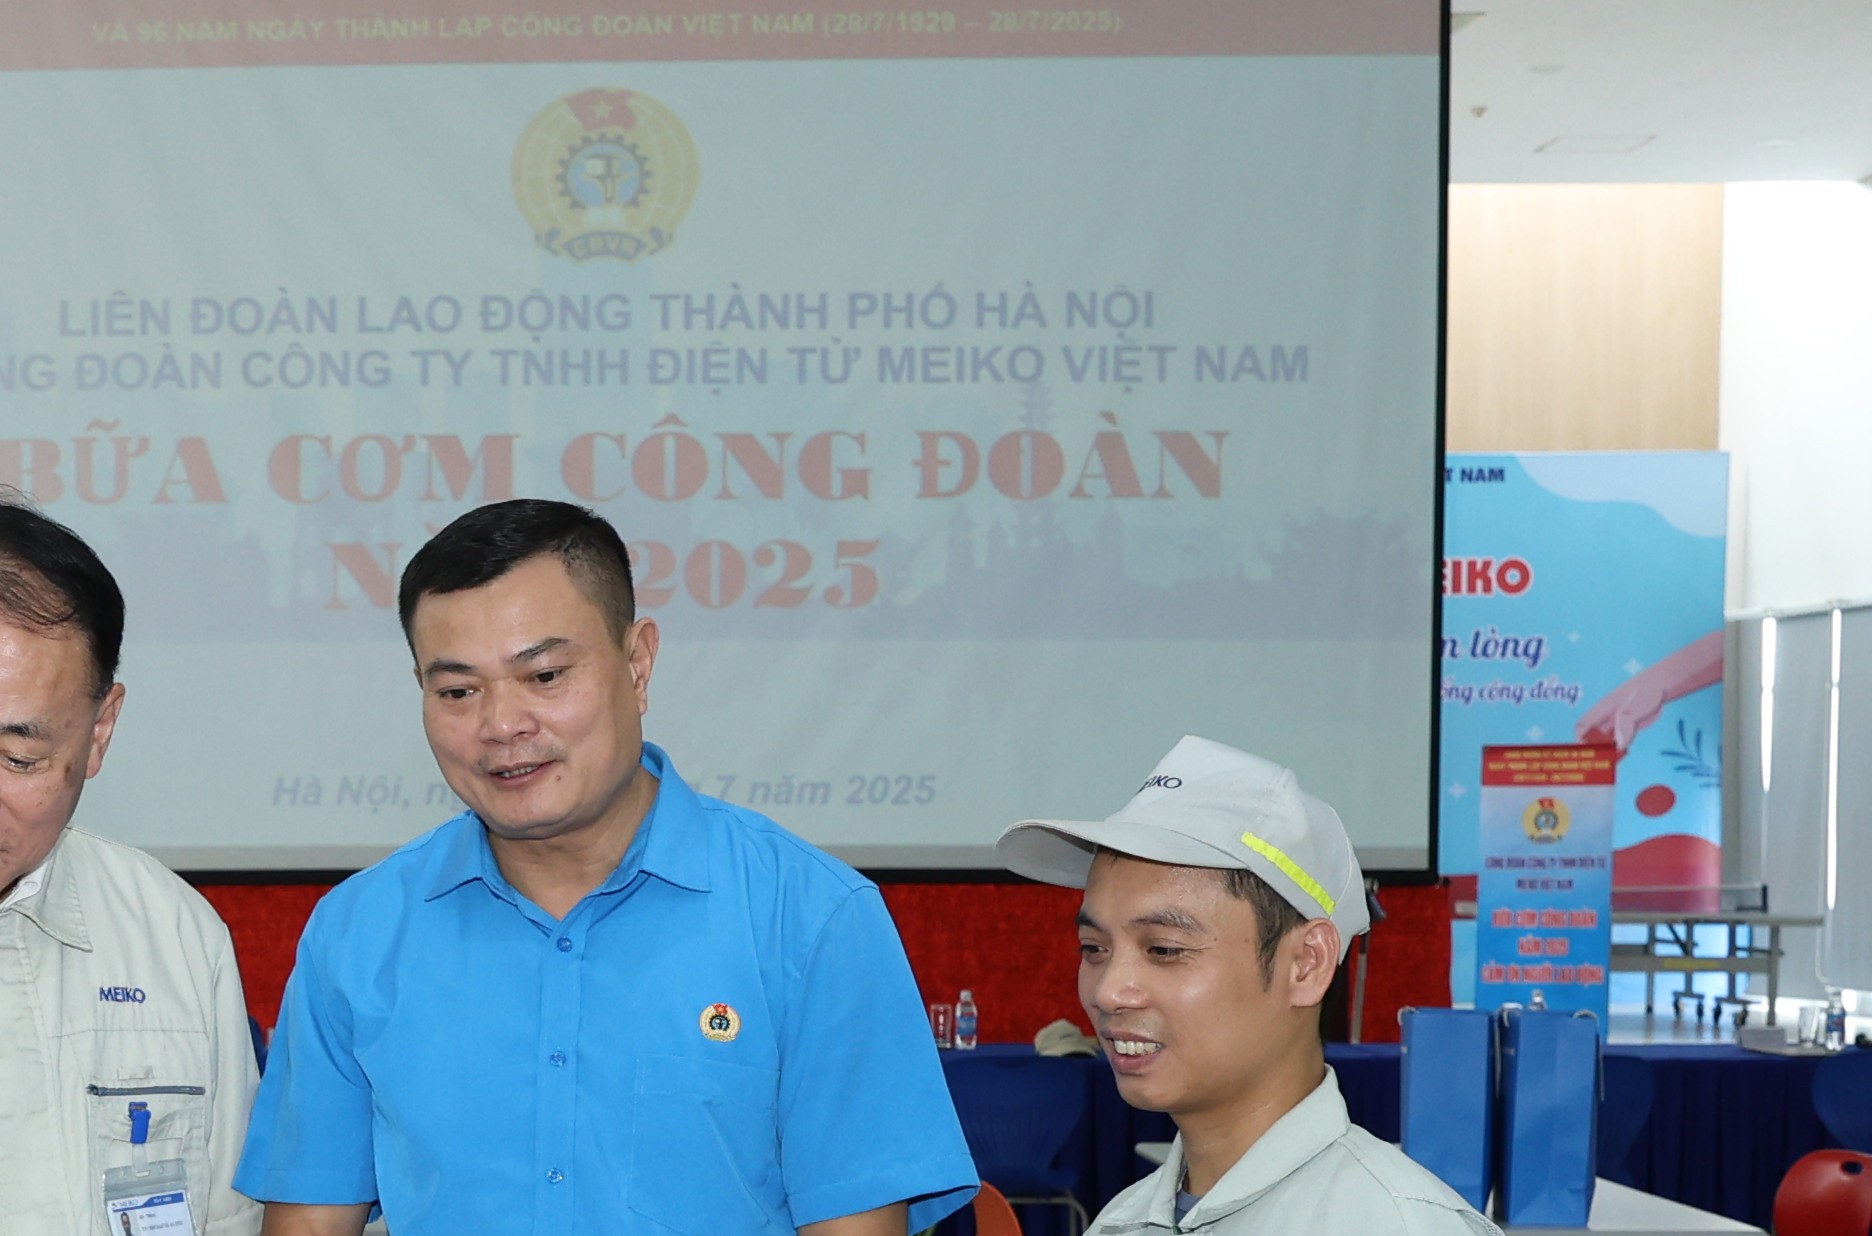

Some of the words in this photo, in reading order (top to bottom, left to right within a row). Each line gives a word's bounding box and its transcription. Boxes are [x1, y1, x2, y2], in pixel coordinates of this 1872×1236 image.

[752, 13, 814, 34] NAM
[58, 290, 171, 338] LIÊN
[190, 287, 338, 336] ĐOÀN
[357, 293, 461, 334] LAO
[480, 285, 631, 346] ĐỘNG
[650, 281, 829, 332] THÀNH
[848, 278, 956, 331] PHỐ
[975, 280, 1048, 330] HÀ
[1065, 284, 1155, 340] NỘI
[74, 340, 222, 392] ĐOÀN
[242, 340, 391, 390] CÔNG
[410, 348, 473, 387] TY
[497, 347, 629, 386] TNHH
[647, 338, 769, 396] ĐIỆN
[787, 335, 860, 384] TỬ
[878, 344, 1045, 384] MEIKO
[1060, 336, 1176, 396] VIỆT
[1195, 344, 1310, 383] NAM
[266, 432, 520, 504] CƠM
[561, 413, 872, 502] CÔNG
[913, 412, 1231, 499] ĐOÀN
[1460, 467, 1505, 482] NAM
[628, 539, 881, 611] 2025
[1443, 558, 1531, 595] IKO
[1470, 625, 1544, 668] lòng
[273, 774, 323, 806] Hà
[714, 774, 732, 802] 7
[747, 773, 829, 805] năm
[846, 774, 937, 806] 2025
[99, 986, 146, 1004] MEIKO
